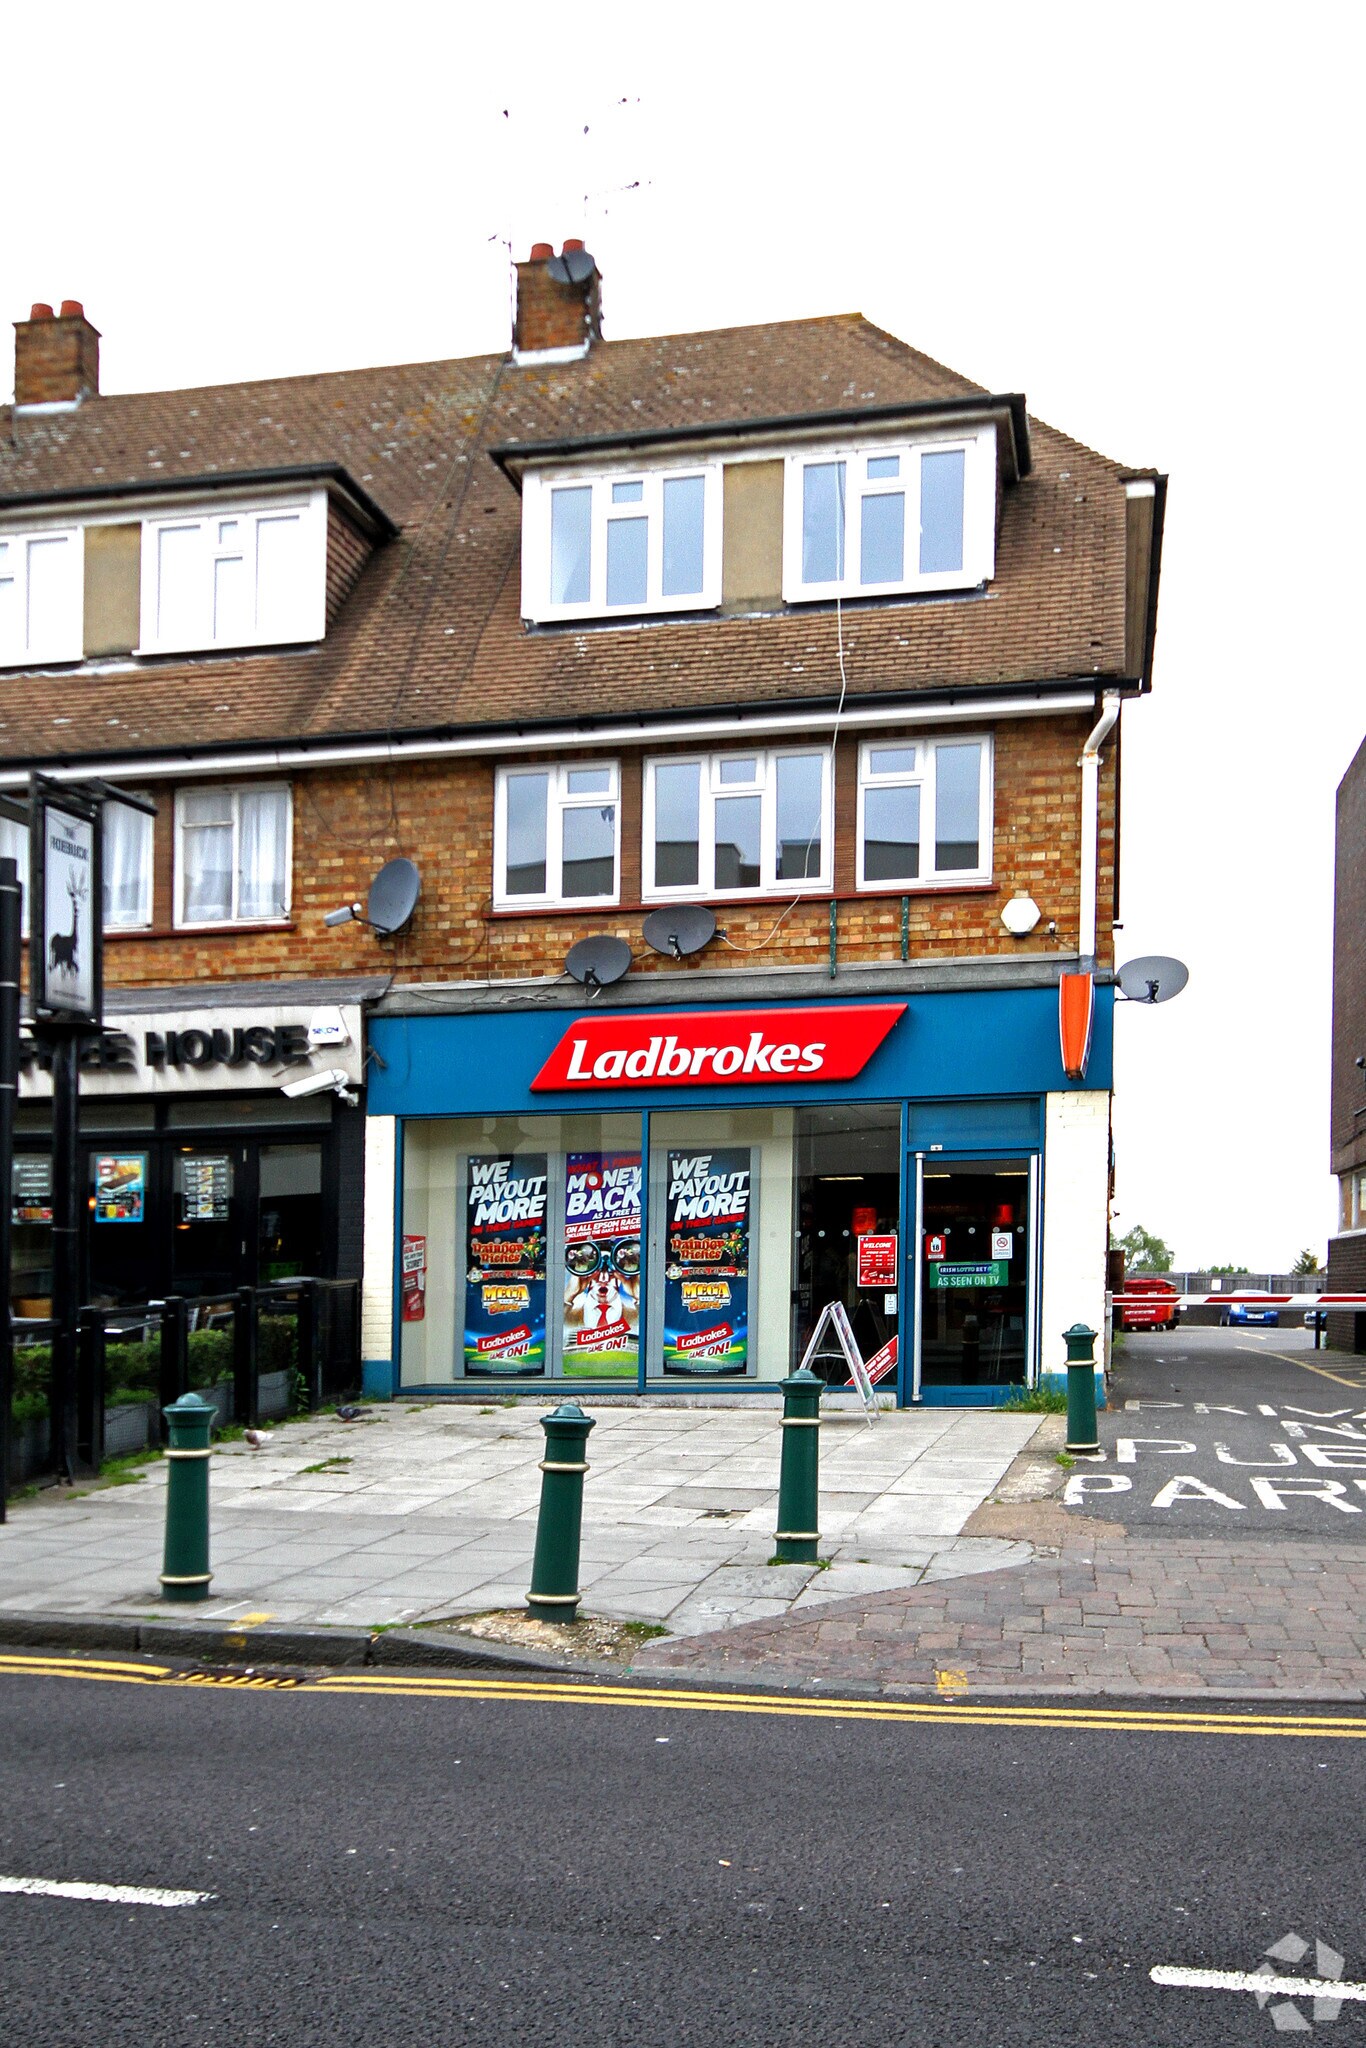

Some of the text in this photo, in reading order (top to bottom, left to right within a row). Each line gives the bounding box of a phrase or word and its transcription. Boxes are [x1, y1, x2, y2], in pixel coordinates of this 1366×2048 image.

[145, 1025, 310, 1068] HOUSE
[566, 1032, 826, 1081] Ladbrokes
[472, 1161, 511, 1185] WE
[672, 1155, 712, 1180] WE
[567, 1166, 642, 1193] MONEY
[669, 1171, 750, 1200] PAYOUT
[469, 1176, 546, 1205] PAYOUT
[566, 1183, 641, 1216] BACK
[474, 1194, 546, 1226] MORE
[592, 1212, 603, 1220] AS
[604, 1211, 611, 1219] A
[611, 1208, 630, 1217] FREE
[674, 1190, 750, 1222] MORE
[566, 1226, 577, 1234] ON
[578, 1223, 592, 1232] ALL
[593, 1220, 619, 1230] EPSOM
[682, 1283, 730, 1299] MEGA
[937, 1275, 1000, 1286] AS SEEN ON TV
[482, 1285, 530, 1301] MEGA
[482, 1330, 526, 1349] Ladbrokes
[581, 1323, 625, 1342] Ladbrokes
[681, 1327, 727, 1348] Ladbrokes
[489, 1343, 529, 1360] GAME ON!
[588, 1336, 628, 1353] GAME ON!
[689, 1341, 731, 1359] GAME ON!
[1125, 1401, 1366, 1419] PRIV
[1062, 1474, 1366, 1513] PAR
